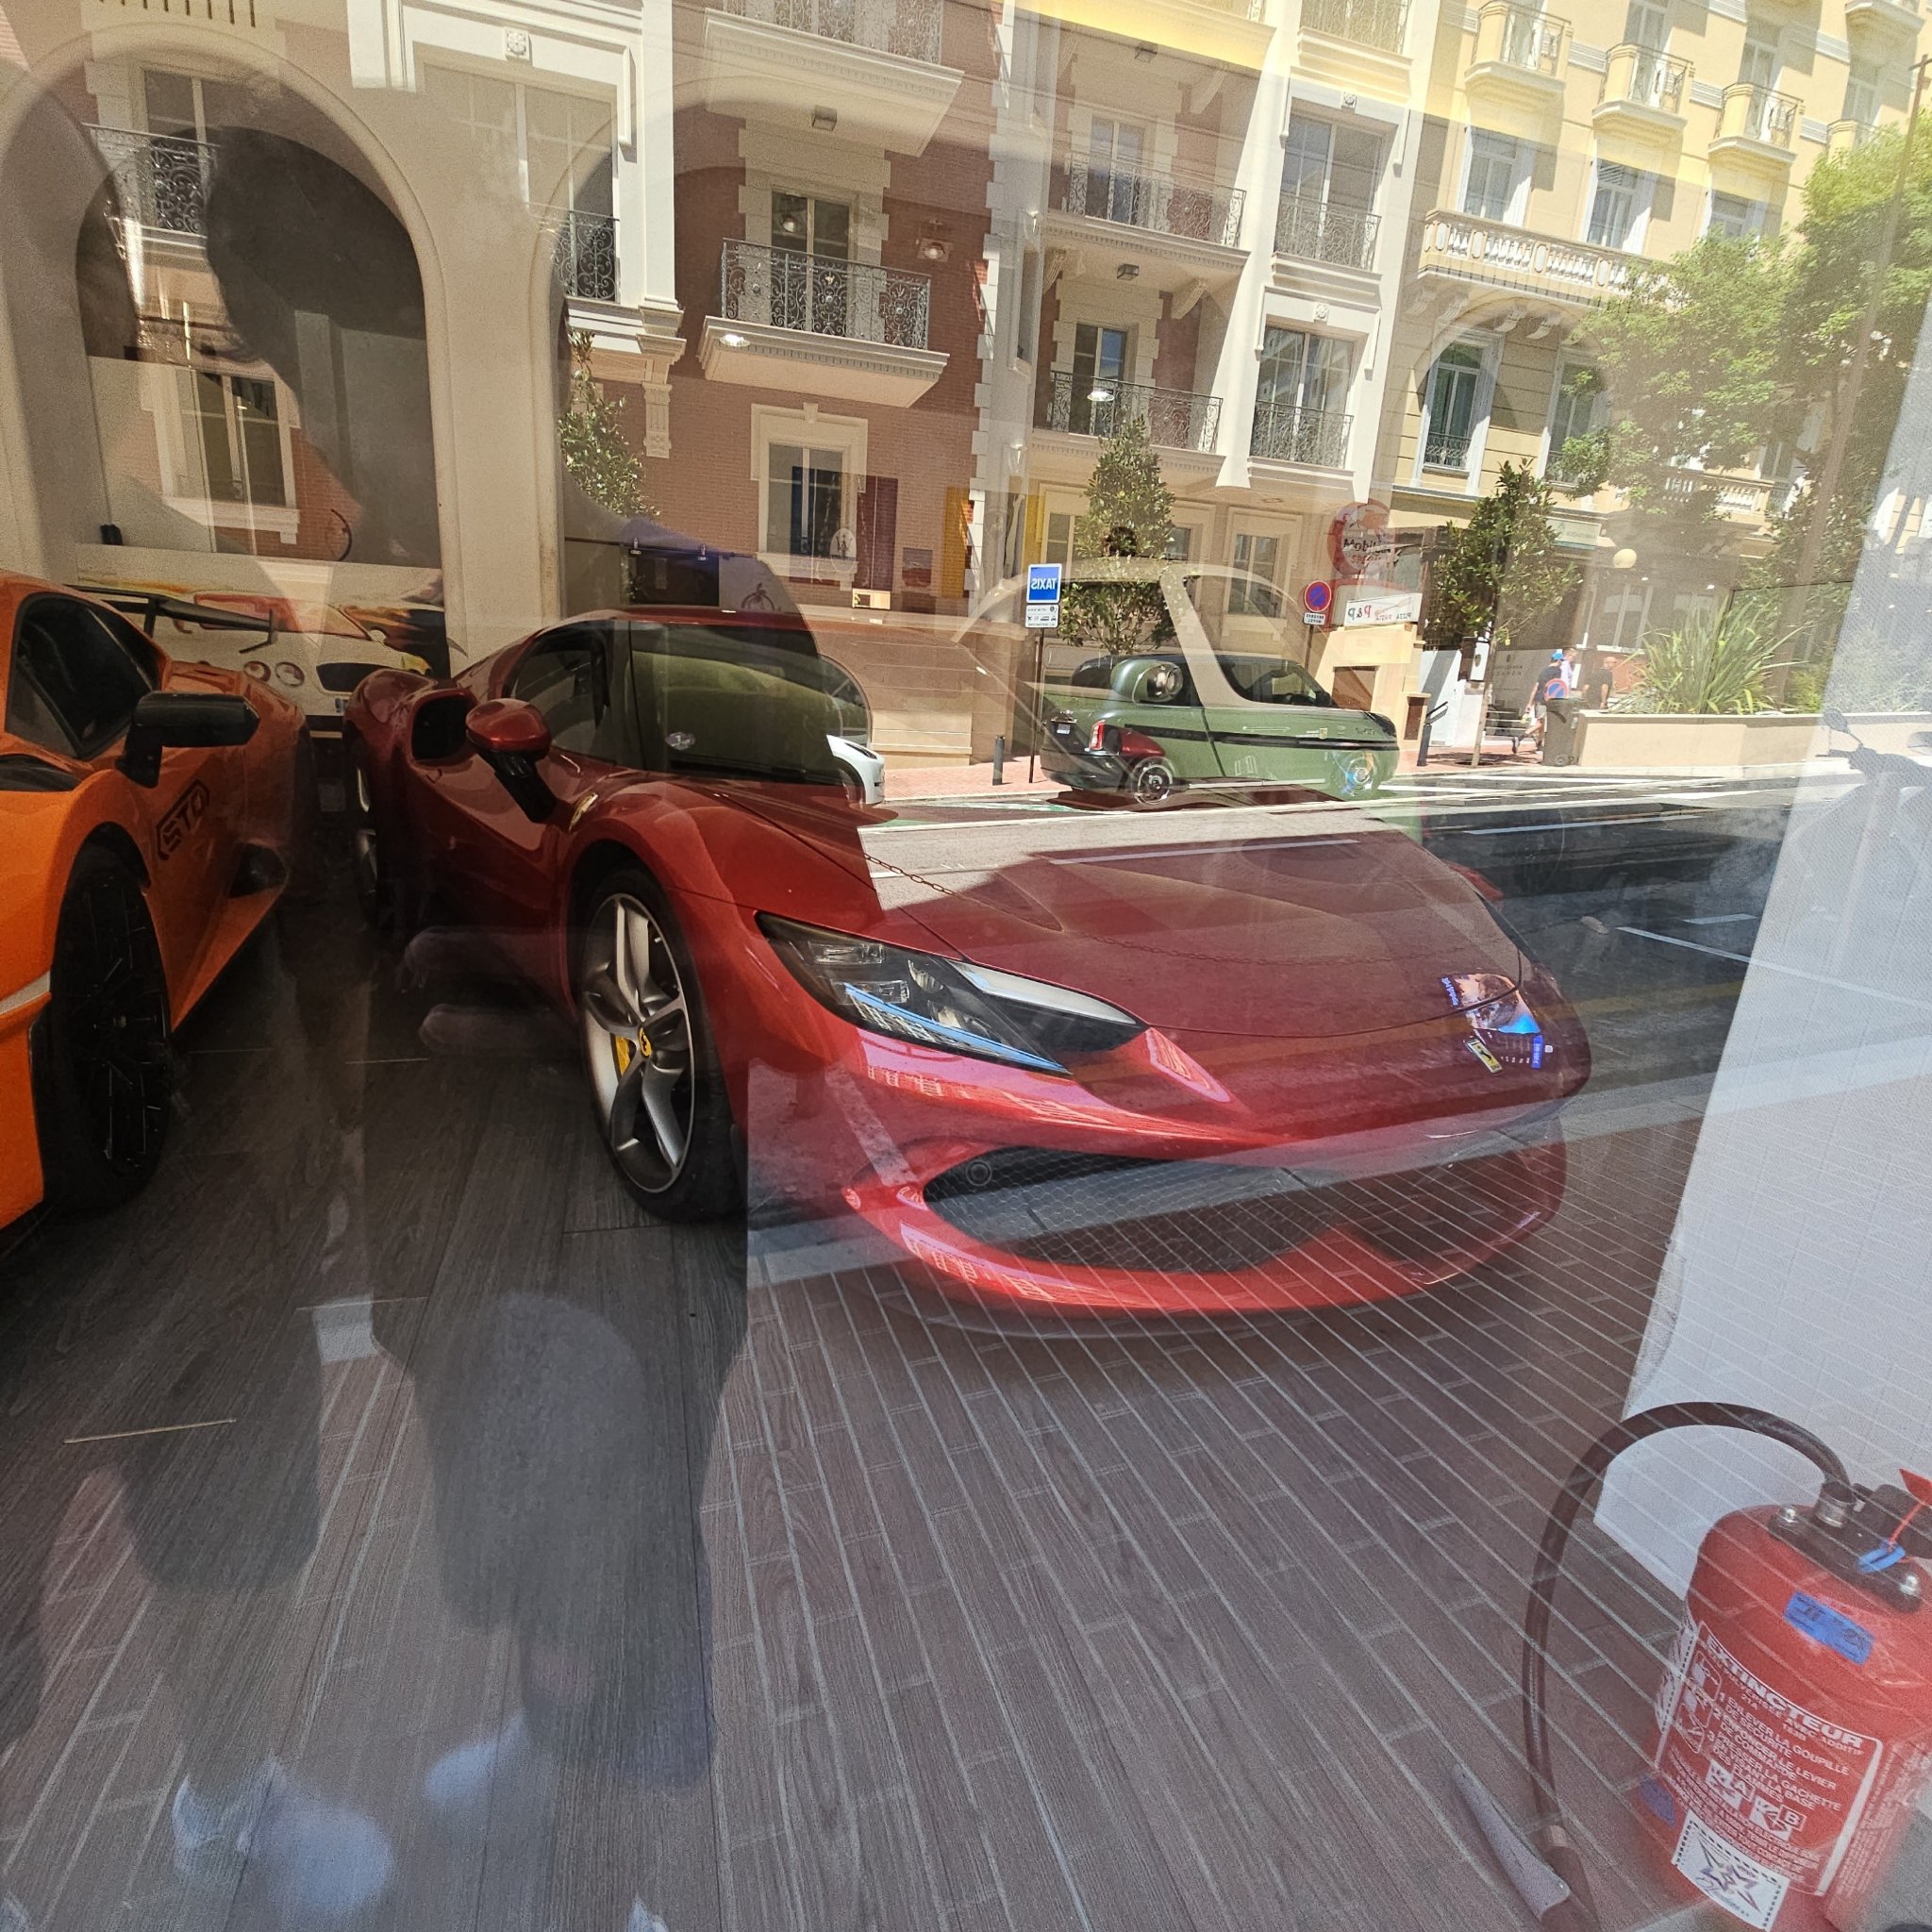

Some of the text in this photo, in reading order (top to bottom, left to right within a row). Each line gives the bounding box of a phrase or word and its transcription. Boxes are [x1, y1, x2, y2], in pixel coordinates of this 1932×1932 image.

[161, 785, 205, 854] STO
[1706, 1634, 1862, 1749] EXTINCTEUR
[1724, 1705, 1739, 1720] DE
[1720, 1722, 1734, 1737] DE
[1733, 1733, 1797, 1781] COMMANDE
[1727, 1696, 1774, 1737] ENLEVER
[1774, 1733, 1790, 1748] LA
[1791, 1744, 1849, 1775] GOUPILLE
[1717, 1731, 1762, 1772] PRESSER
[1763, 1770, 1779, 1782] LA
[1780, 1779, 1840, 1810] GACHETTE
[1727, 1750, 1767, 1782] VISANT
[1767, 1778, 1783, 1793] LA
[1783, 1790, 1816, 1809] BASE
[1731, 1763, 1784, 1803] FLAMMES
[1735, 1780, 1746, 1794] A
[1777, 1757, 1795, 1772] LE
[1794, 1766, 1836, 1790] LEVIER
[1784, 1810, 1801, 1826] B
